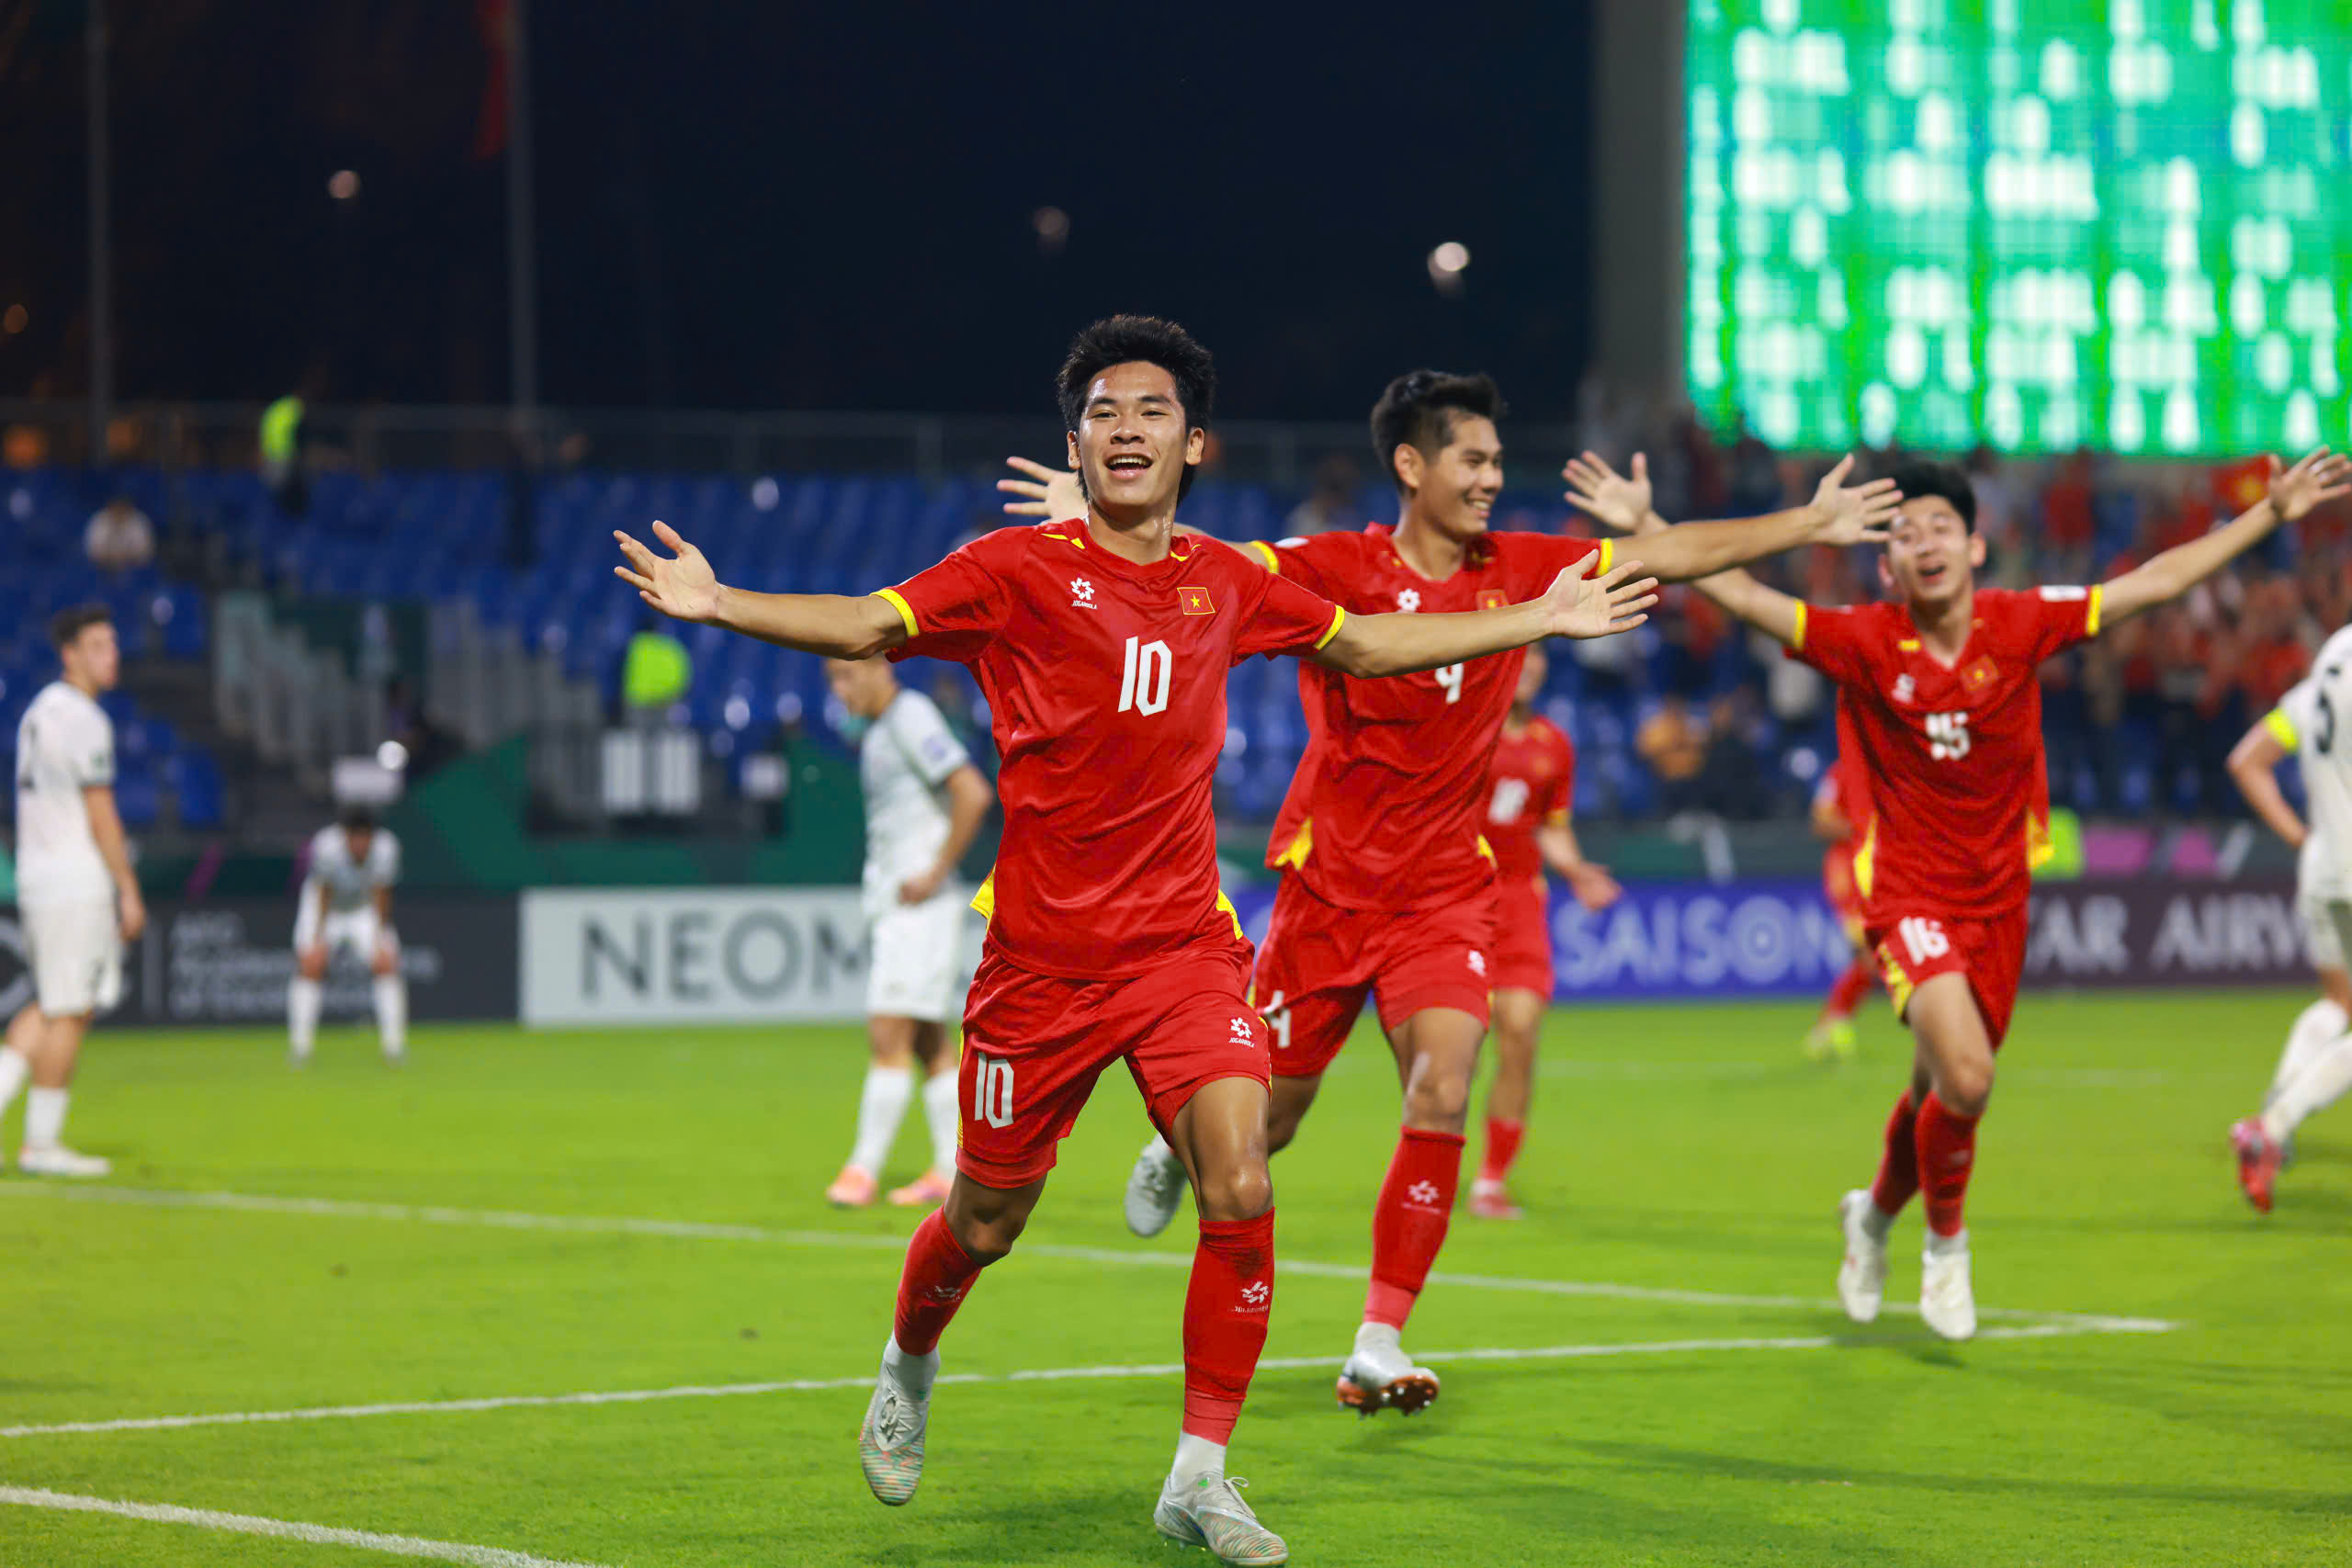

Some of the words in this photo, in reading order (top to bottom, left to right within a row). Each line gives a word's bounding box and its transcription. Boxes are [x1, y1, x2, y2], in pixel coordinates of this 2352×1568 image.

[1117, 636, 1171, 716] 10
[579, 909, 871, 1001] NEOM
[1898, 916, 1951, 966] 16
[974, 1051, 1014, 1129] 10
